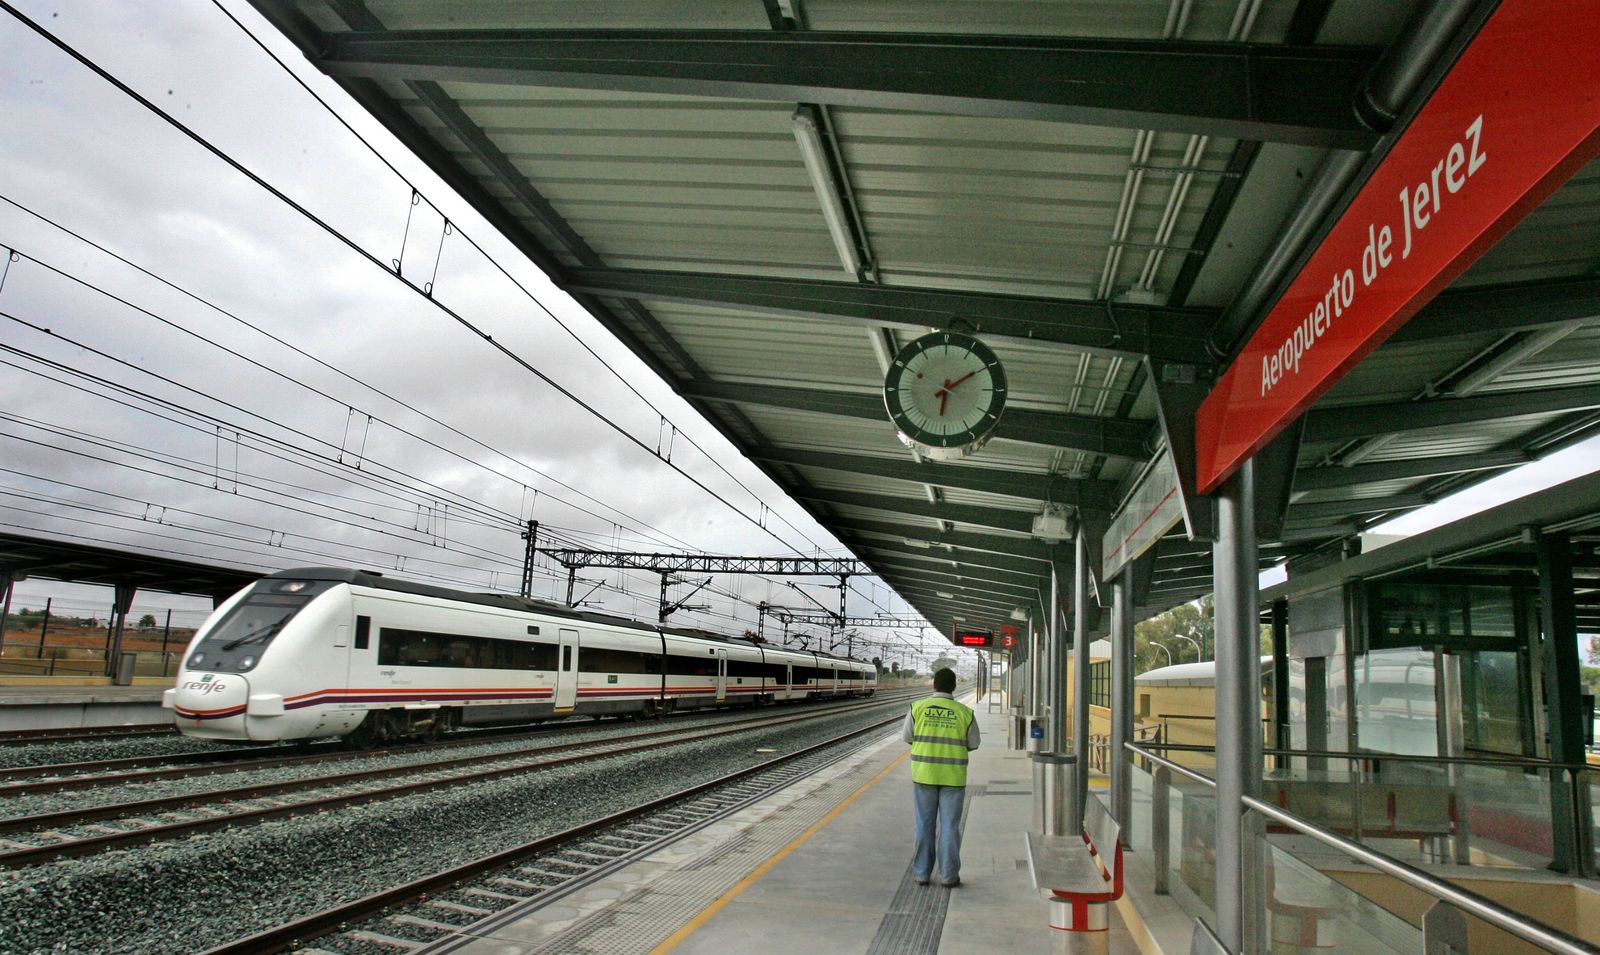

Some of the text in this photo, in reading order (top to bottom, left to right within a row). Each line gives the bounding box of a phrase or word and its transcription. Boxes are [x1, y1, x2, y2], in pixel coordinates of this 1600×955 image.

[1261, 114, 1487, 397] Aeropuerto de Jerez
[1005, 635, 1012, 647] 3
[182, 680, 226, 696] renfe
